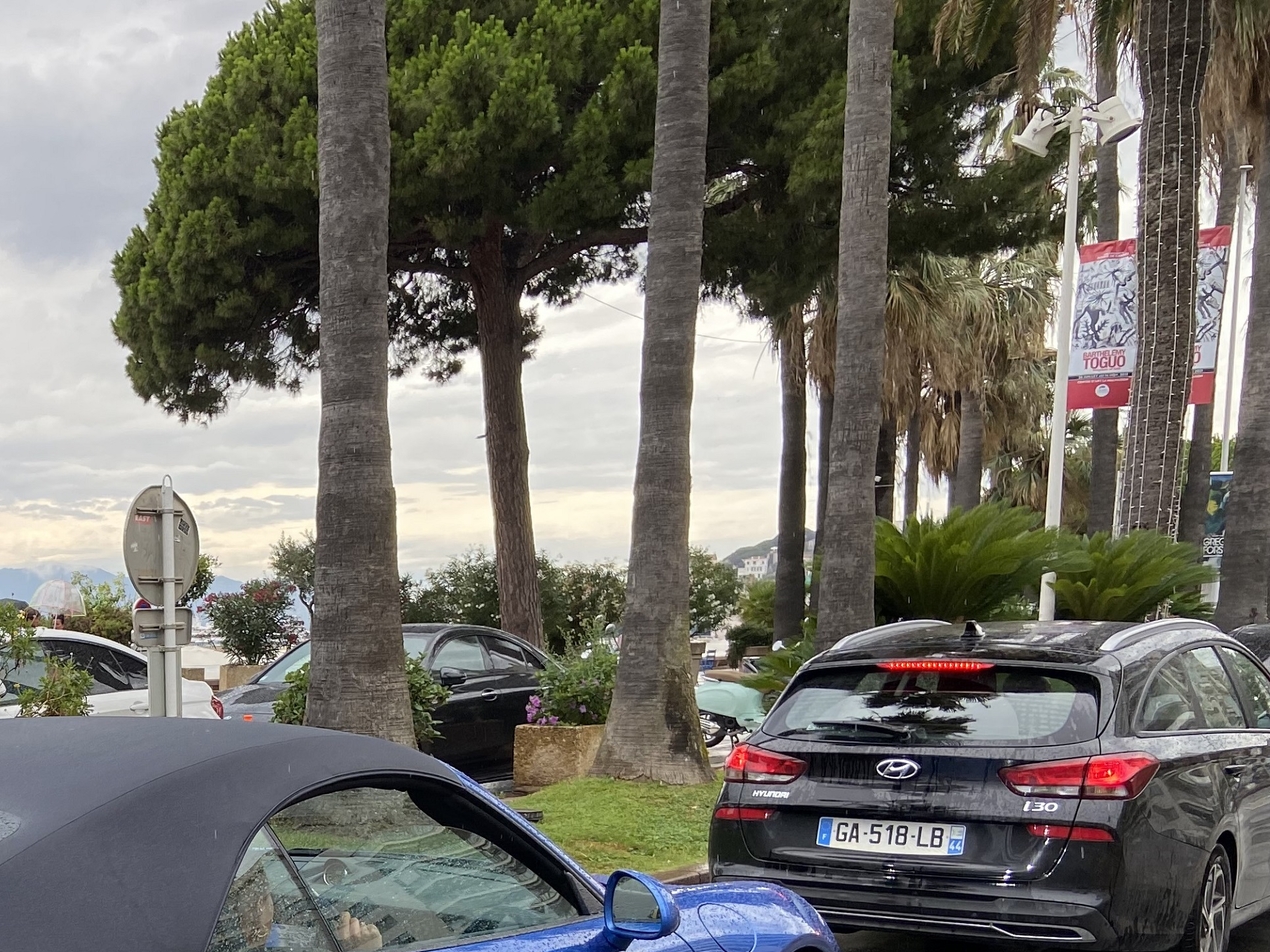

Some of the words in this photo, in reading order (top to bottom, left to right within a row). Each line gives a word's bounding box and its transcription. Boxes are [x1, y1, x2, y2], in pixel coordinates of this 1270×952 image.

[1083, 355, 1126, 369] TOGUO
[752, 789, 790, 799] HYUNDAI
[1023, 801, 1058, 812] i30
[835, 822, 944, 848] GA-518-LB
[949, 840, 962, 851] 44
